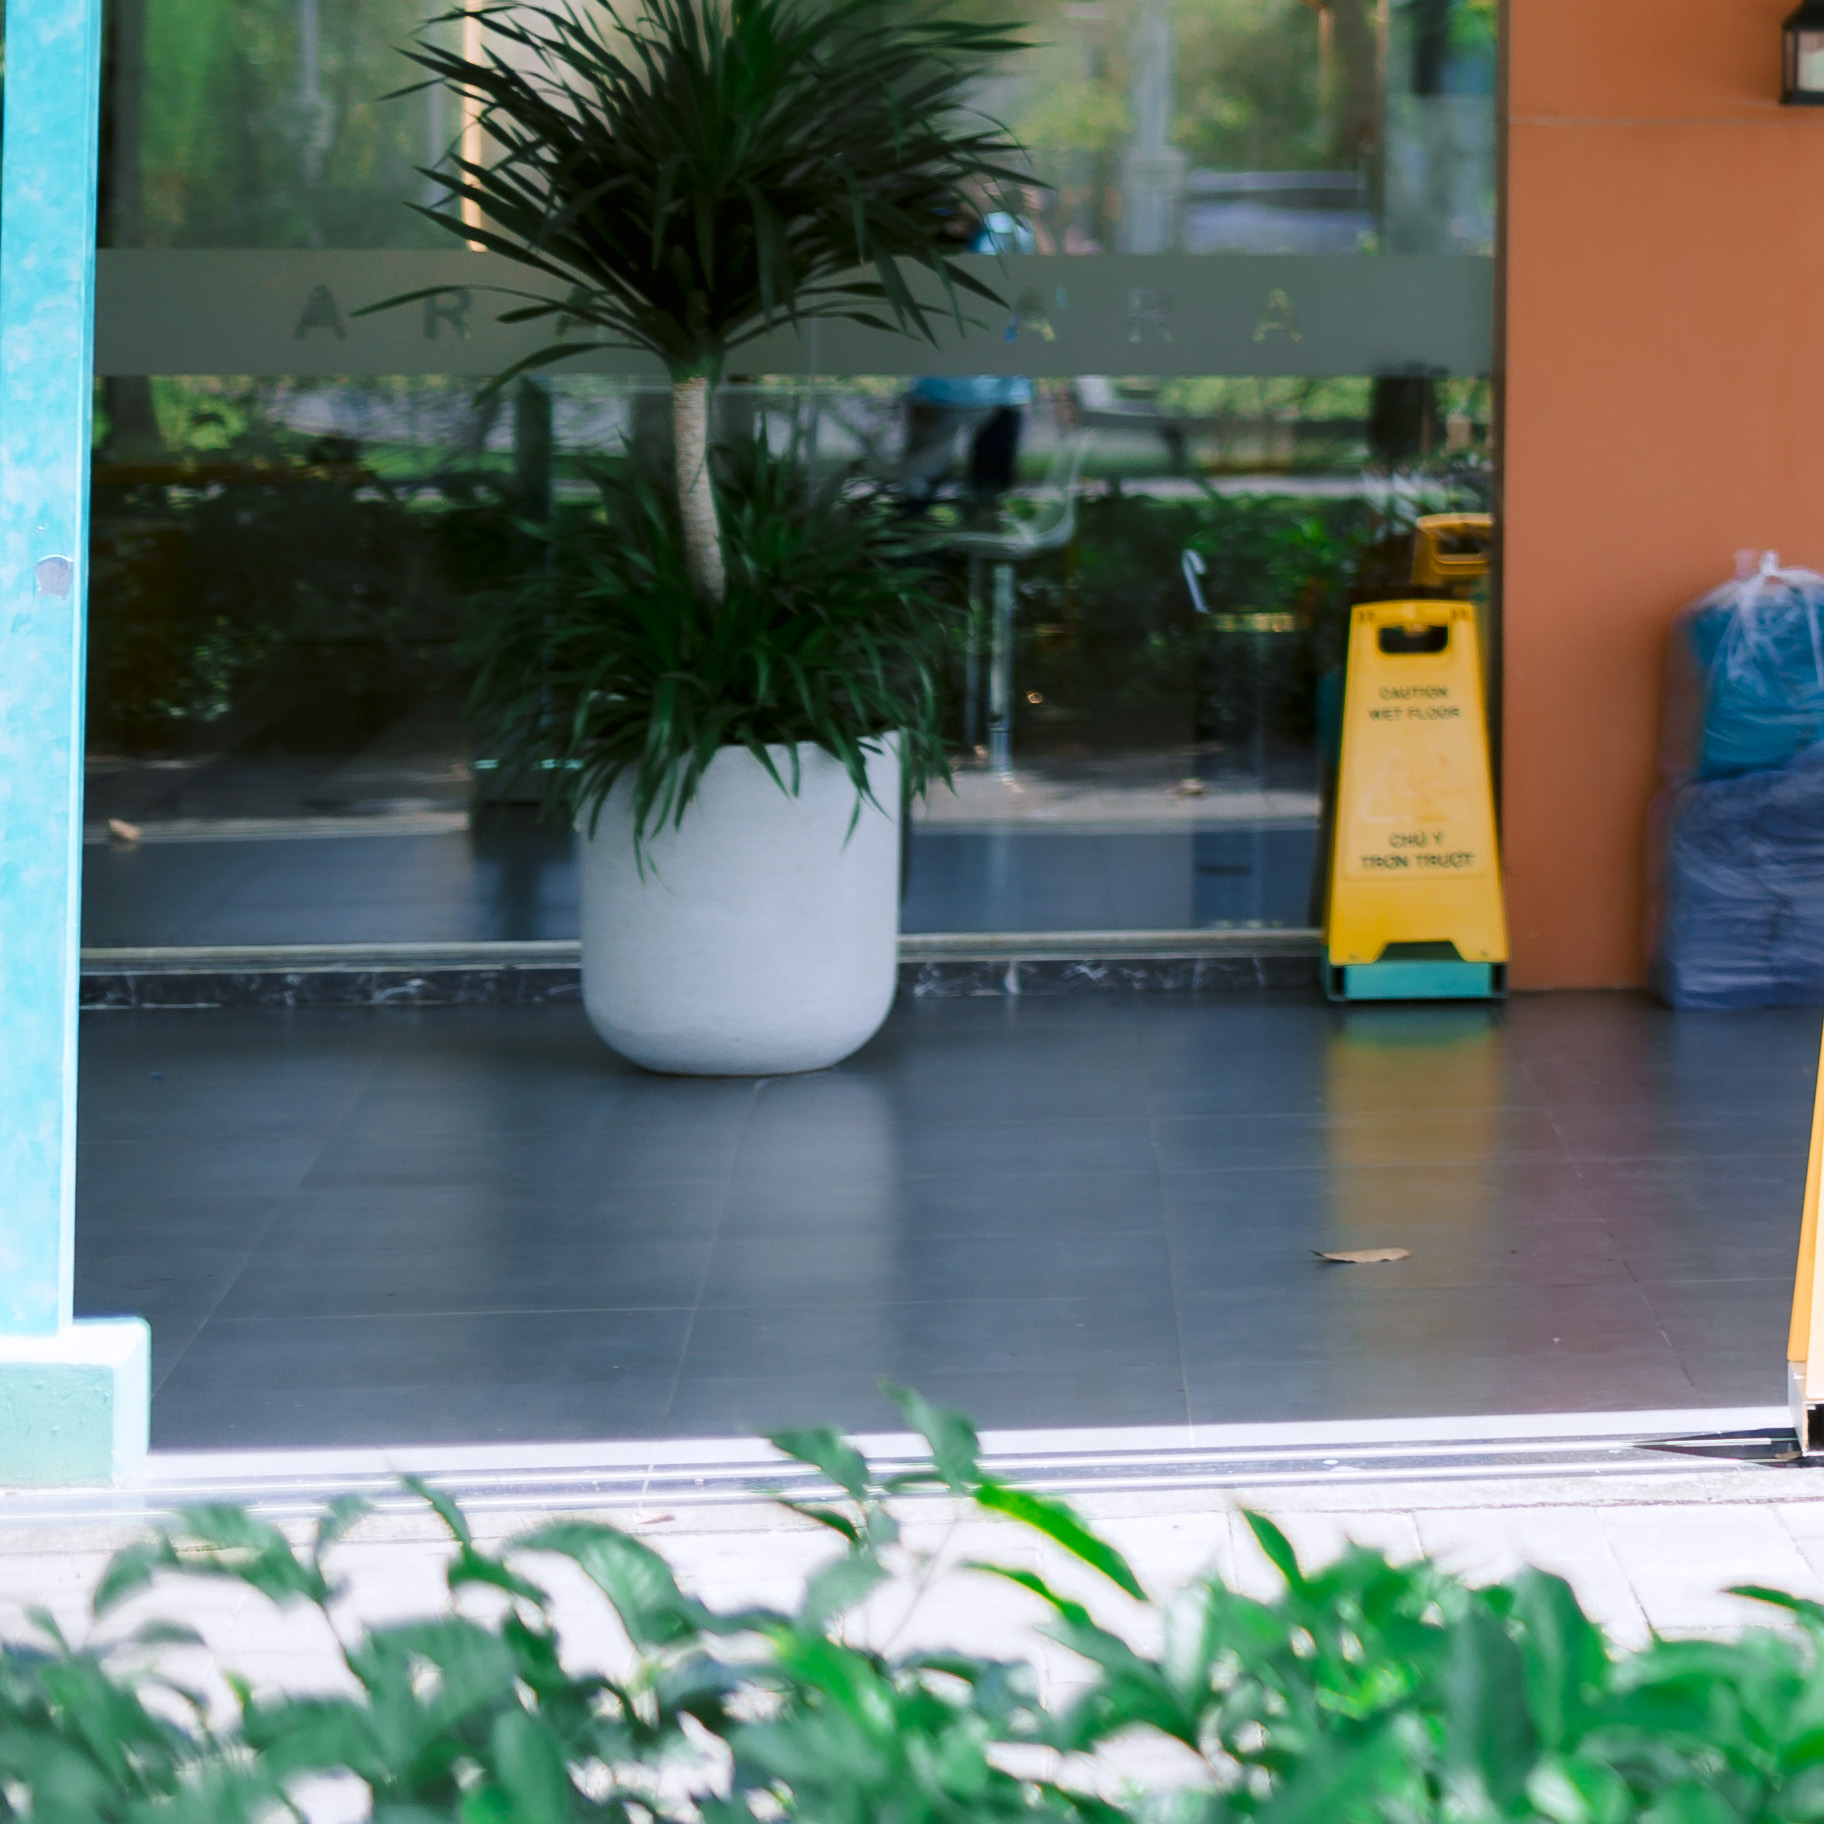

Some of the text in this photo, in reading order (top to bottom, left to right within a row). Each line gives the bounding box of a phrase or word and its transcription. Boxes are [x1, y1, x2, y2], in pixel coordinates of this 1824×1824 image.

[1378, 685, 1449, 701] CAUTION
[1367, 704, 1461, 722] WET FLOOR
